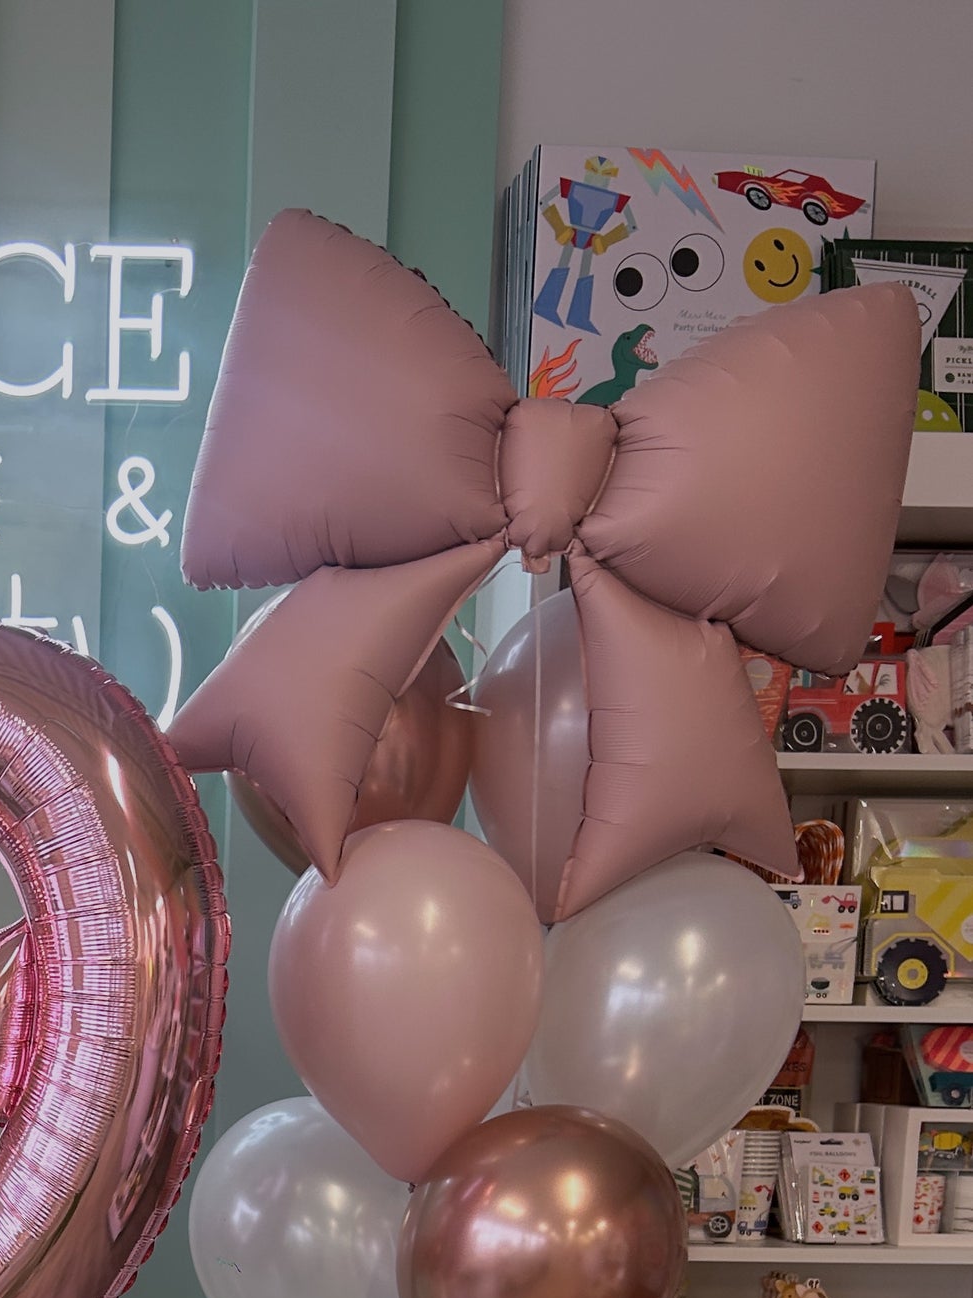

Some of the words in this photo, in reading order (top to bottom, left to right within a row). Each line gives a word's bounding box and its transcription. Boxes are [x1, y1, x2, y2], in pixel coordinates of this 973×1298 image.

[898, 280, 938, 300] EBALL
[673, 323, 694, 333] Party
[106, 455, 174, 548] &
[769, 1095, 799, 1107] ZONE
